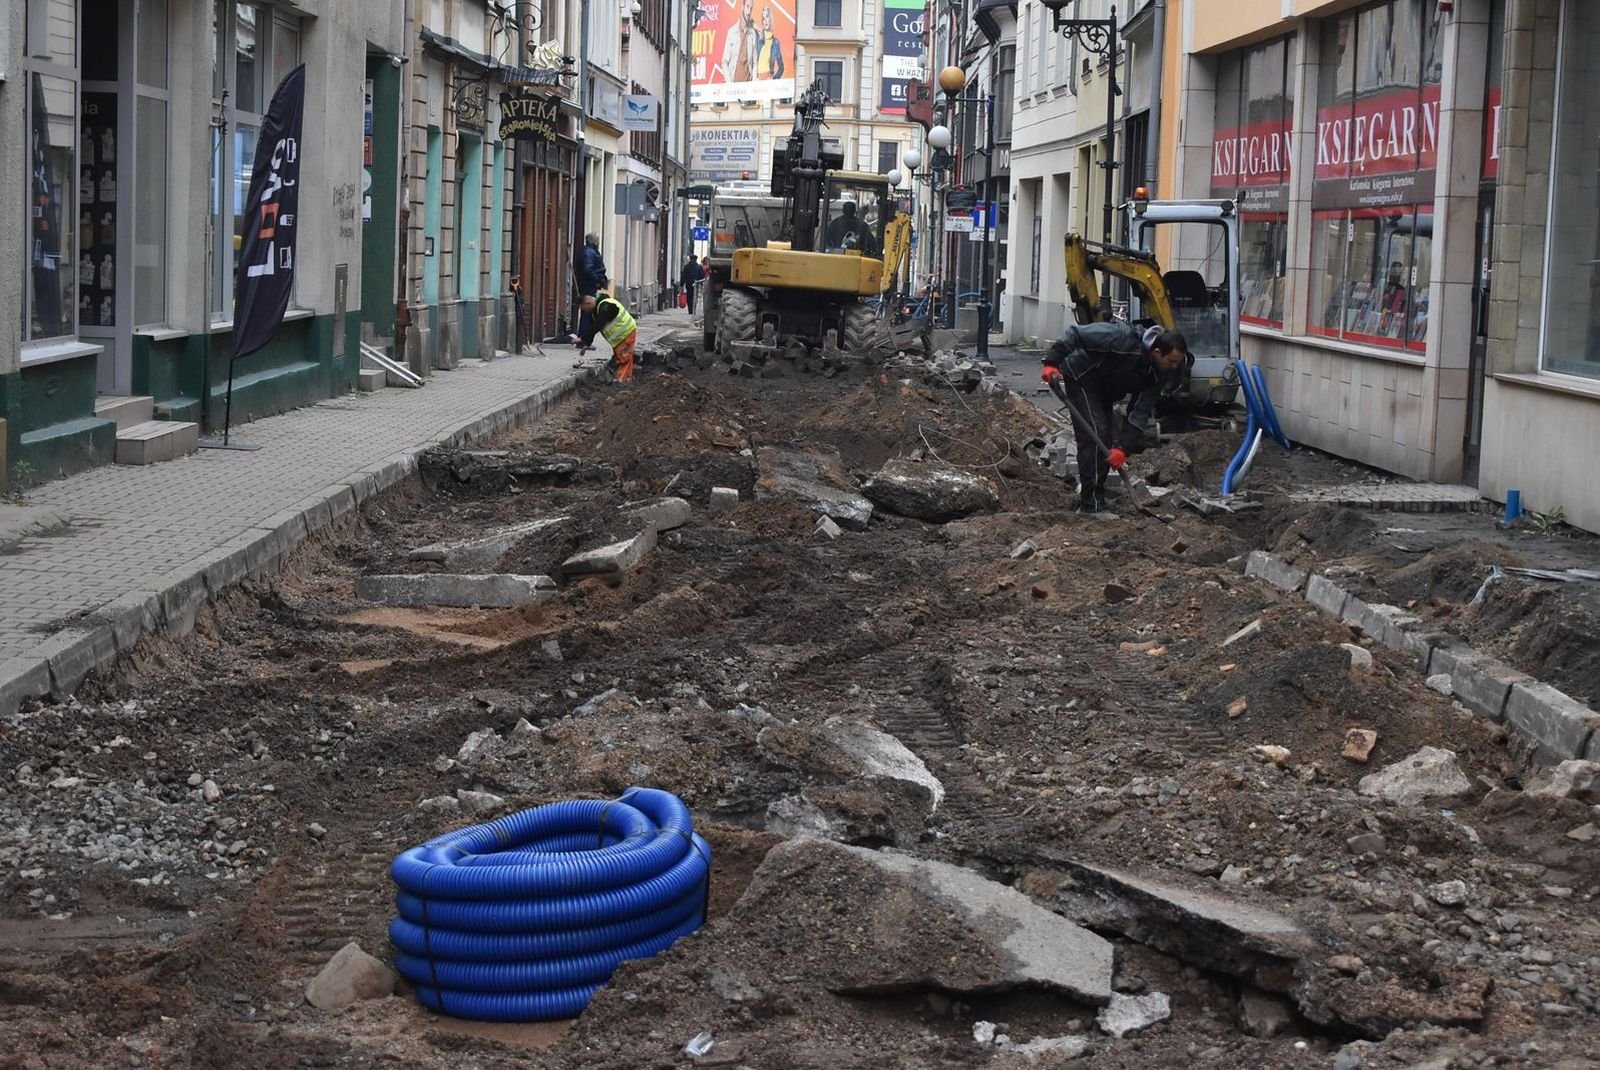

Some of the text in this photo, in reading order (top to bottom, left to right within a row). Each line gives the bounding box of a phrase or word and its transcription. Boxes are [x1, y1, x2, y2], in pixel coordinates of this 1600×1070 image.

[501, 99, 557, 122] APTEKA
[701, 130, 750, 140] KONEKTIA
[1316, 100, 1441, 172] KSIĘGARN
